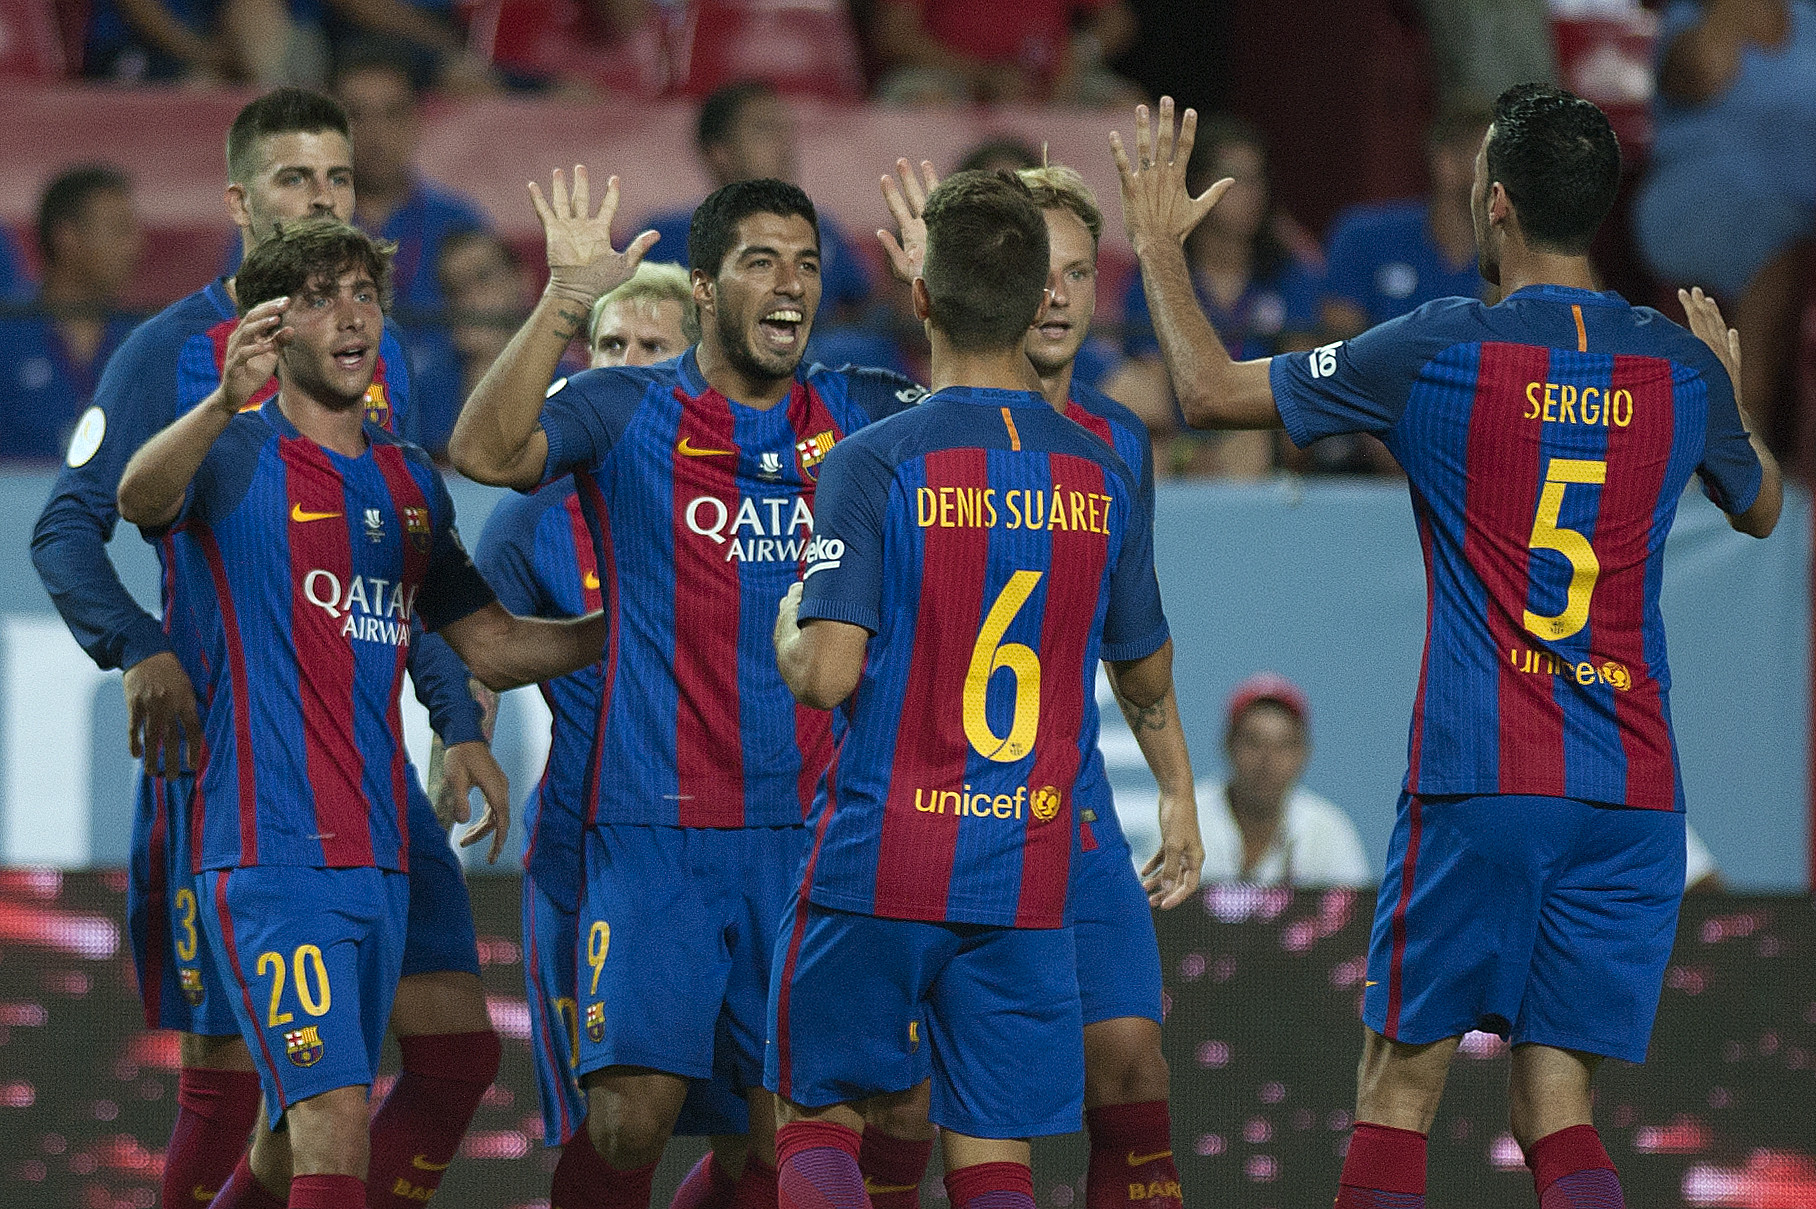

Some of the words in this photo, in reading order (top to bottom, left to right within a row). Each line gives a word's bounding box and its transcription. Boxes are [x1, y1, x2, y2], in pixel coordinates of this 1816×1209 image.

[1523, 381, 1634, 428] SERGIO
[685, 496, 814, 545] QATA
[916, 486, 998, 529] DENIS
[1005, 484, 1114, 535] SUÁREZ
[1522, 457, 1608, 642] 5
[341, 614, 412, 647] AIRWA
[962, 569, 1044, 763] 6
[914, 784, 1027, 820] unicef
[174, 888, 199, 962] 3
[587, 920, 612, 996] 9
[256, 944, 332, 1028] 20
[1128, 1181, 1183, 1202] BAR
